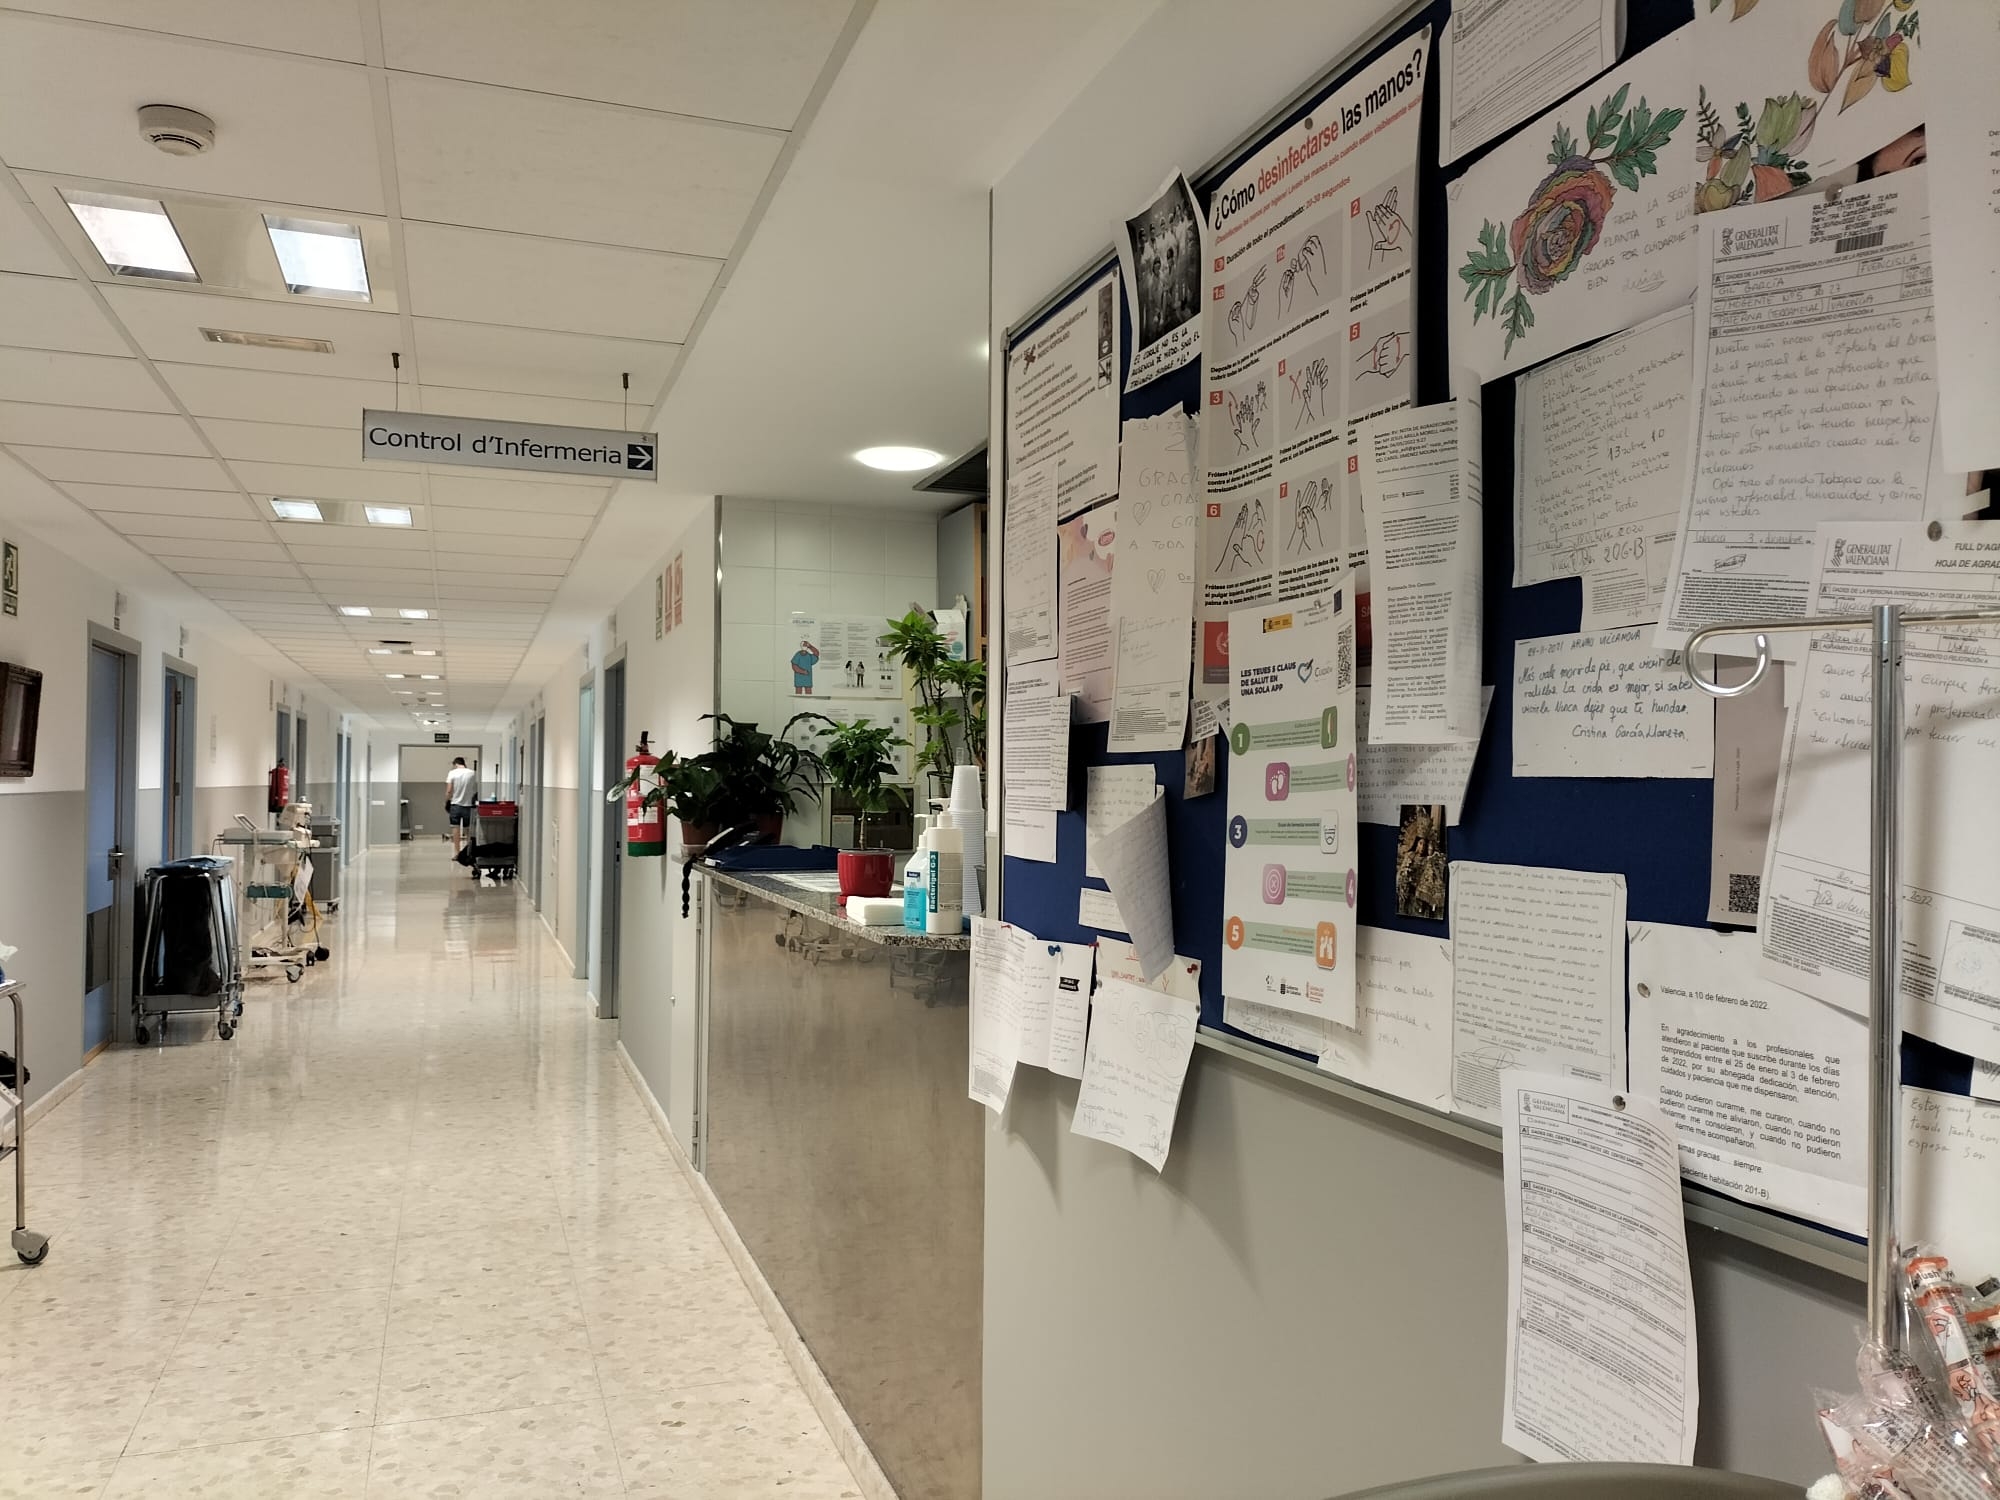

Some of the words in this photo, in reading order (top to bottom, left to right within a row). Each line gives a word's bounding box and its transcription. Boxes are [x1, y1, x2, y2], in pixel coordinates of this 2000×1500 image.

[1214, 183, 1255, 230] ¿Cómo
[1257, 121, 1339, 194] desinfectarse
[1341, 104, 1362, 134] las
[1365, 48, 1422, 117] manos?
[1735, 224, 1779, 241] GENERALITAT
[1735, 237, 1779, 251] VALENCIANA
[369, 427, 461, 452] Control
[472, 436, 622, 464] d'Infermeria
[1846, 543, 1893, 555] GENERALITAT
[1954, 543, 1975, 551] FULL
[1845, 555, 1889, 567] VALENCIANA
[1240, 669, 1252, 677] LES
[1252, 666, 1270, 675] TEUES
[1277, 662, 1296, 672] CLAUS
[1618, 662, 1635, 680] que
[1666, 650, 1681, 665] de
[1240, 679, 1249, 687] DE
[1250, 676, 1269, 685] SALUT
[1270, 675, 1278, 683] EN
[1241, 688, 1254, 696] UNA
[1254, 686, 1270, 695] SOLA
[1271, 683, 1283, 692] APP
[1582, 681, 1602, 694] vida
[1572, 724, 1608, 738] Cristina
[1660, 985, 1688, 998] Valencia,
[1694, 990, 1704, 1000] 10
[1705, 992, 1715, 1001] de
[1715, 994, 1739, 1006] febrero
[1739, 997, 1749, 1007] de
[1661, 1023, 1669, 1032] En
[1676, 1027, 1725, 1044] agradecimiento
[1747, 1039, 1757, 1049] los
[1766, 1043, 1815, 1060] profesionales
[1824, 1055, 1840, 1066] que
[1661, 1034, 1692, 1046] atendieron
[1693, 1039, 1699, 1048] al
[1700, 1043, 1730, 1056] paciente
[1731, 1048, 1745, 1059] que
[1747, 1050, 1777, 1063] suscribe
[1778, 1057, 1806, 1070] durante
[1808, 1063, 1820, 1073] los
[1661, 1044, 1702, 1060] comprendidos
[1704, 1053, 1723, 1064] entre
[1725, 1057, 1732, 1066] el
[1734, 1058, 1744, 1068] 25
[1746, 1060, 1756, 1070] de
[1758, 1064, 1778, 1076] enero
[1781, 1068, 1788, 1078] al
[1790, 1070, 1796, 1079] 3
[1798, 1072, 1809, 1082] de
[1811, 1075, 1840, 1088] febrero
[1660, 1065, 1686, 1078] cuidados
[1687, 1073, 1692, 1082] y
[1692, 1072, 1724, 1088] paciencia
[1726, 1080, 1739, 1091] que
[1741, 1083, 1752, 1092] me
[1753, 1085, 1799, 1103] dispensaron.
[1661, 1054, 1669, 1063] de
[1691, 1062, 1703, 1072] por
[1706, 1066, 1716, 1074] su
[1720, 1067, 1755, 1082] abnegada
[1804, 1086, 1840, 1101] atención,
[1532, 1097, 1566, 1110] GENERALITAT
[1533, 1104, 1566, 1115] VALENCIANA
[1660, 1085, 1688, 1098] Cuando
[1685, 1092, 1713, 1106] pudieron
[1716, 1098, 1747, 1114] curarme,
[1750, 1108, 1762, 1117] me
[1765, 1111, 1795, 1126] curaron,
[1798, 1118, 1826, 1133] cuando
[1829, 1126, 1841, 1136] no
[1660, 1097, 1686, 1111] pudieron
[1687, 1104, 1714, 1117] curarme
[1716, 1110, 1728, 1120] me
[1730, 1112, 1762, 1129] aliviaron,
[1765, 1122, 1792, 1137] cuando
[1793, 1129, 1804, 1139] no
[1806, 1133, 1841, 1149] pudieron
[1690, 1115, 1701, 1124] me
[1705, 1118, 1744, 1136] consolaron,
[1750, 1131, 1755, 1139] y
[1760, 1132, 1786, 1146] cuando
[1791, 1141, 1801, 1150] no
[1806, 1144, 1841, 1160] pudieron
[1695, 1127, 1706, 1136] me
[1707, 1130, 1757, 1150] acompañaron.
[1696, 1148, 1721, 1162] gracias
[1709, 1172, 1743, 1191] habitación
[1744, 1184, 1770, 1200] 201-B)
